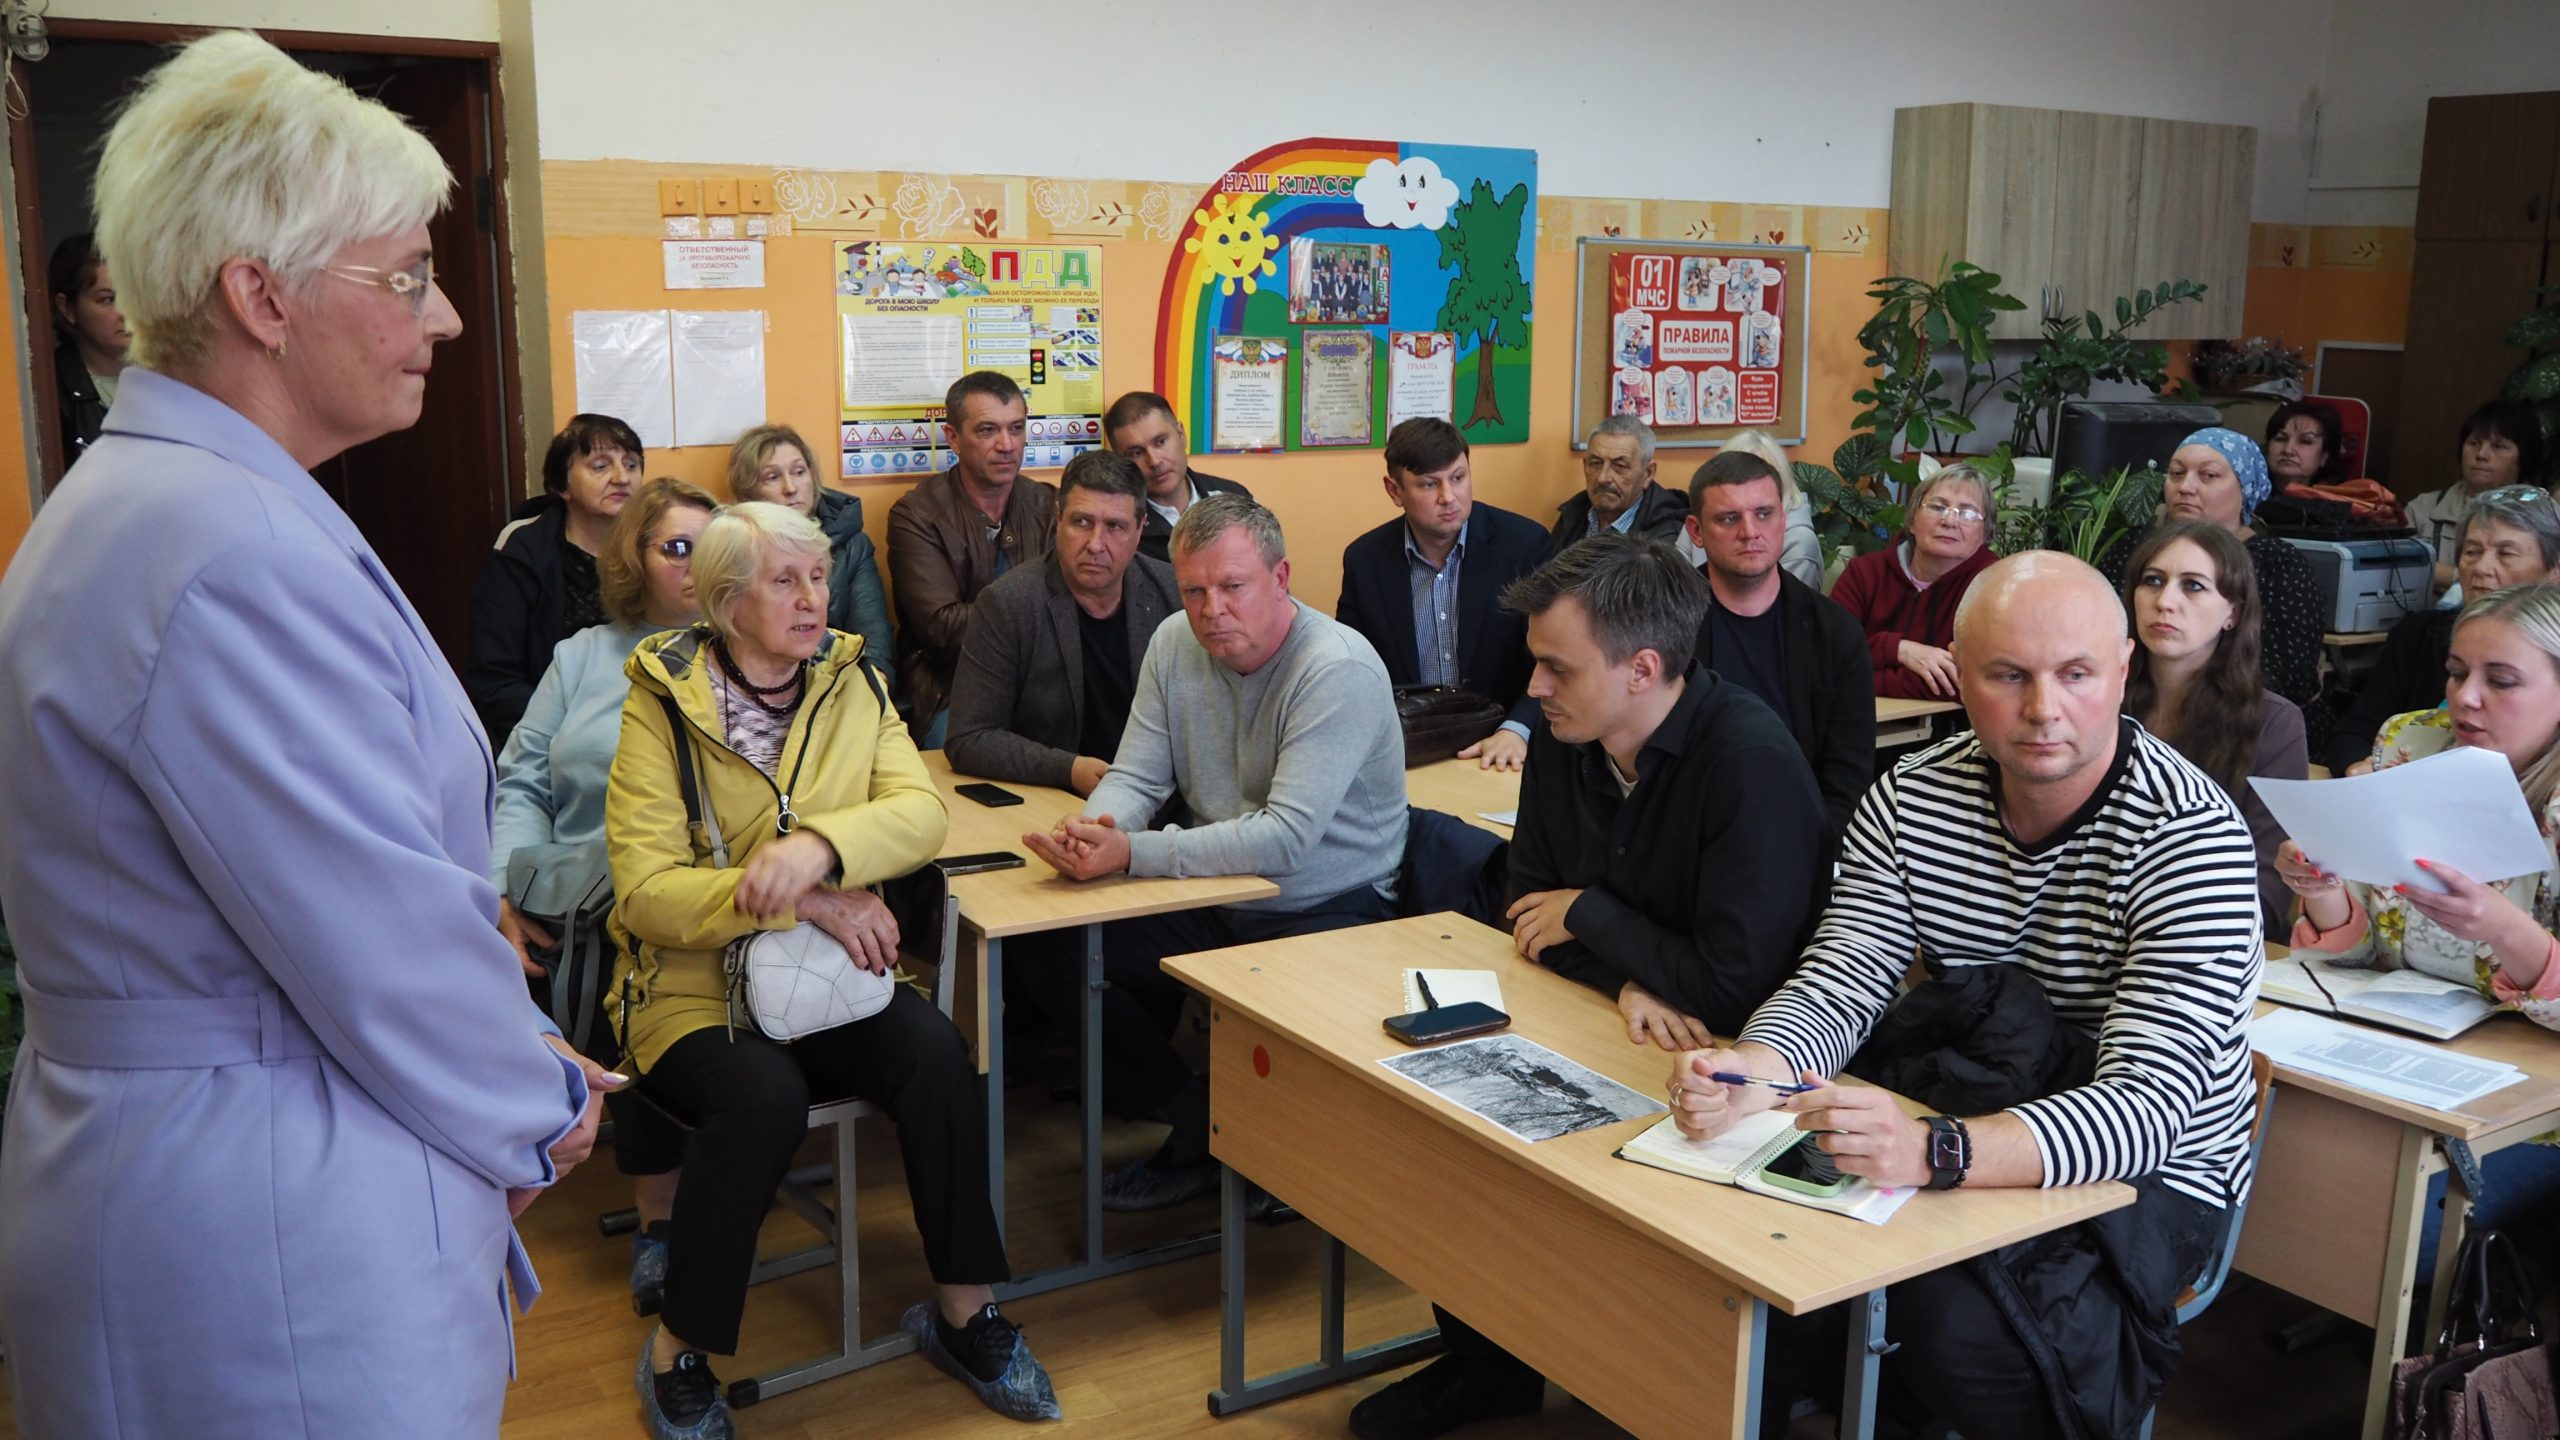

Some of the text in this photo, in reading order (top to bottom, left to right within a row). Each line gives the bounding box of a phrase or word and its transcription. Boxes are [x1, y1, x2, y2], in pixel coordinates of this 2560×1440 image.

[1223, 172, 1352, 196] НАШ КЛАСС
[679, 245, 749, 253] ОТВЕТСТВЕННЫЙ
[990, 249, 1091, 288] ПДД
[1640, 259, 1664, 288] 01
[1636, 288, 1666, 306] МЧС
[1663, 327, 1730, 344] ПРАВИЛА
[1692, 347, 1731, 355] БЕЗОПАСНОСТИ
[1229, 370, 1271, 380] ДИПЛОМ
[1407, 362, 1439, 371] ГРАМОТА
